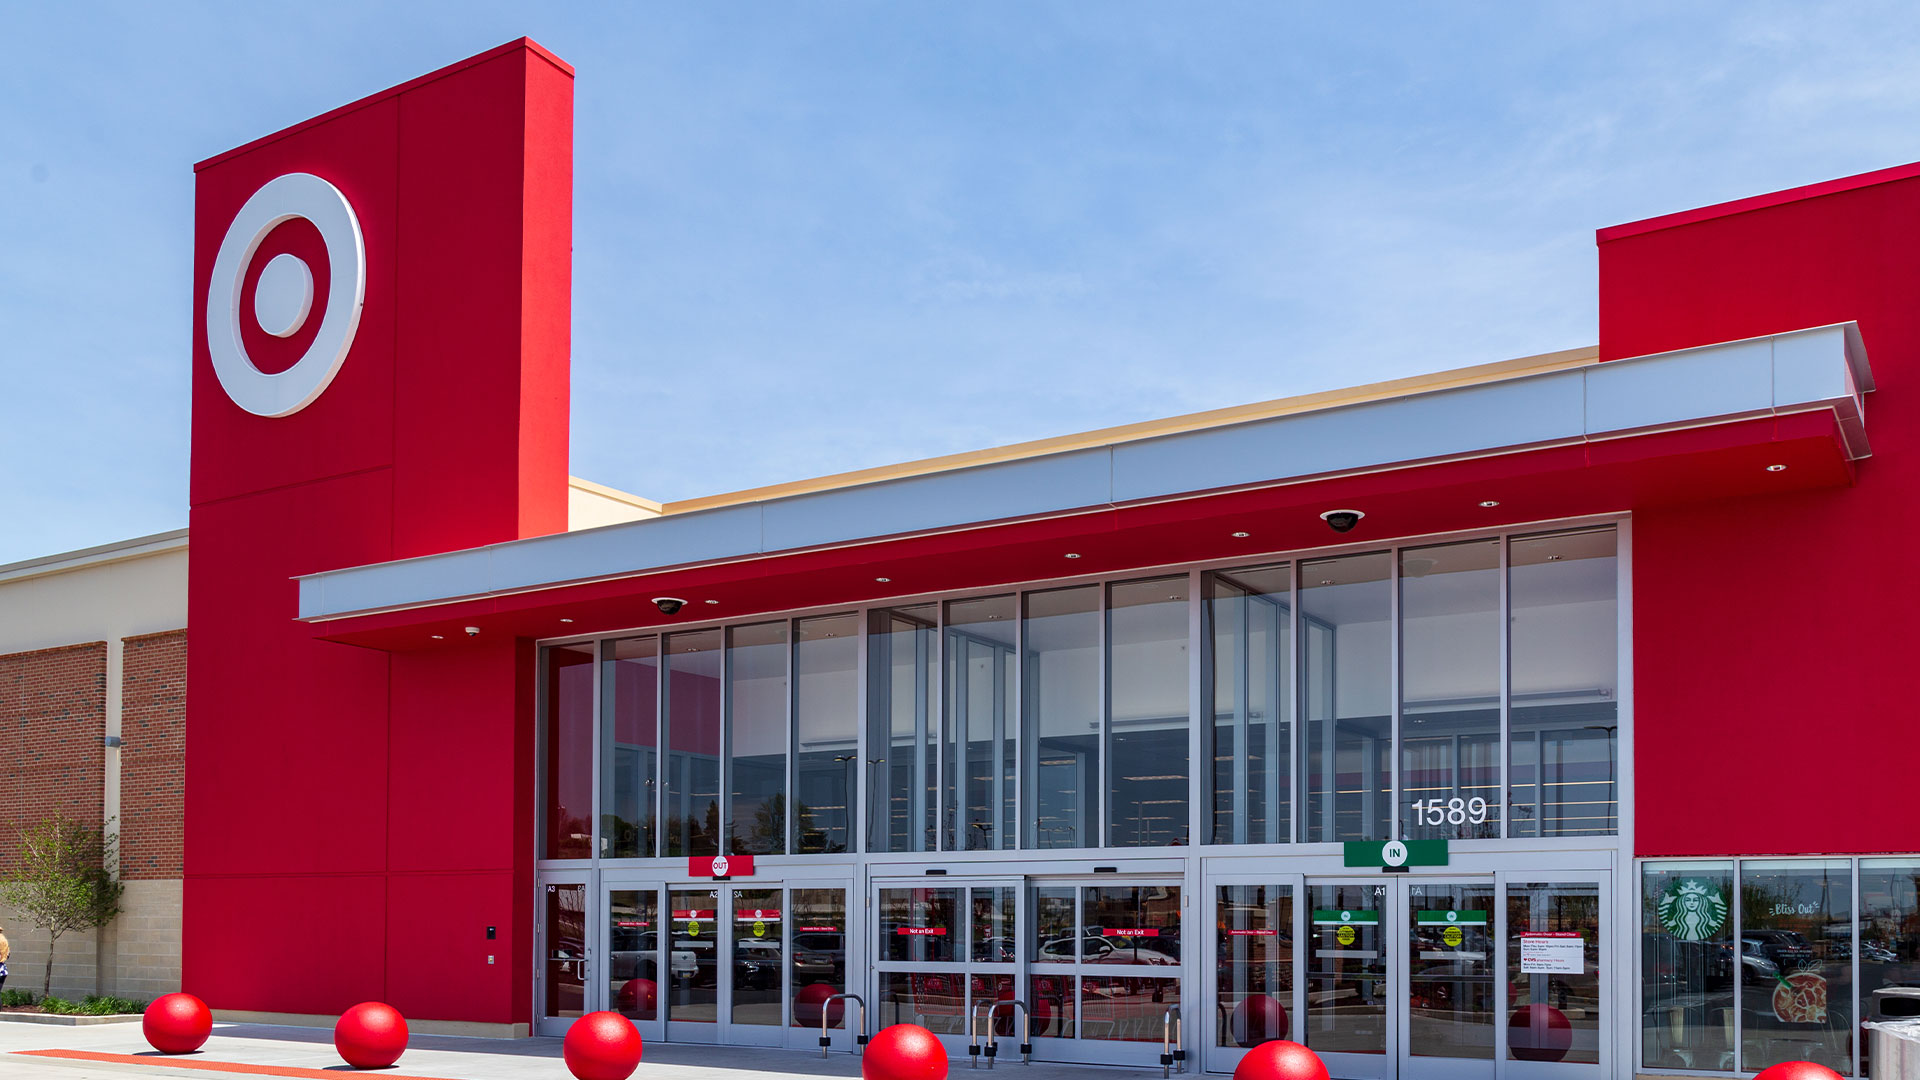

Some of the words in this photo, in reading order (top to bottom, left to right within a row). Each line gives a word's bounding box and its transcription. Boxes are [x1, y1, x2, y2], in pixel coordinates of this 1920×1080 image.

[1411, 797, 1487, 826] 1589
[1389, 848, 1401, 858] IN
[713, 862, 727, 870] OUT
[547, 885, 556, 893] A3
[1374, 887, 1385, 896] A1
[709, 890, 718, 898] A2
[1775, 903, 1796, 915] Bliss
[1798, 903, 1815, 915] Out
